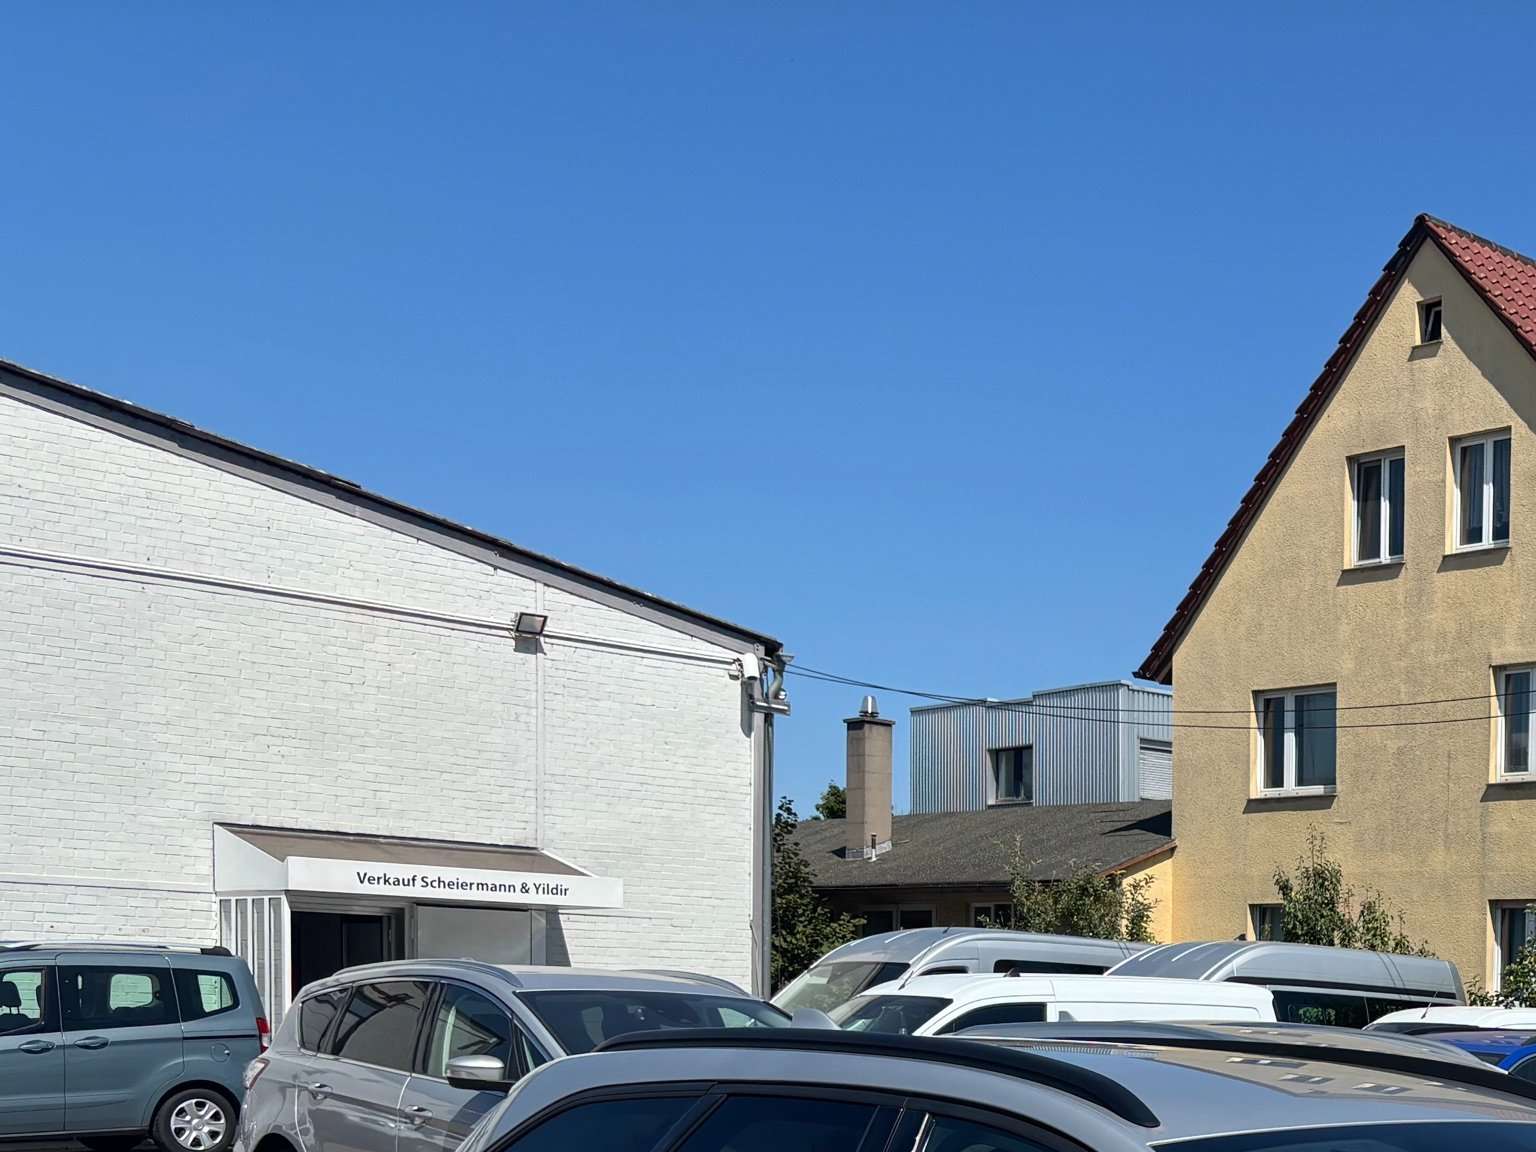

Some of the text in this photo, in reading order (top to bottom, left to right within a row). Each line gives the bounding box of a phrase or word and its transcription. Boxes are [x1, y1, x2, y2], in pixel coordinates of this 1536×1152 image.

[356, 872, 569, 896] Verkauf Scheiermann & Yildir
